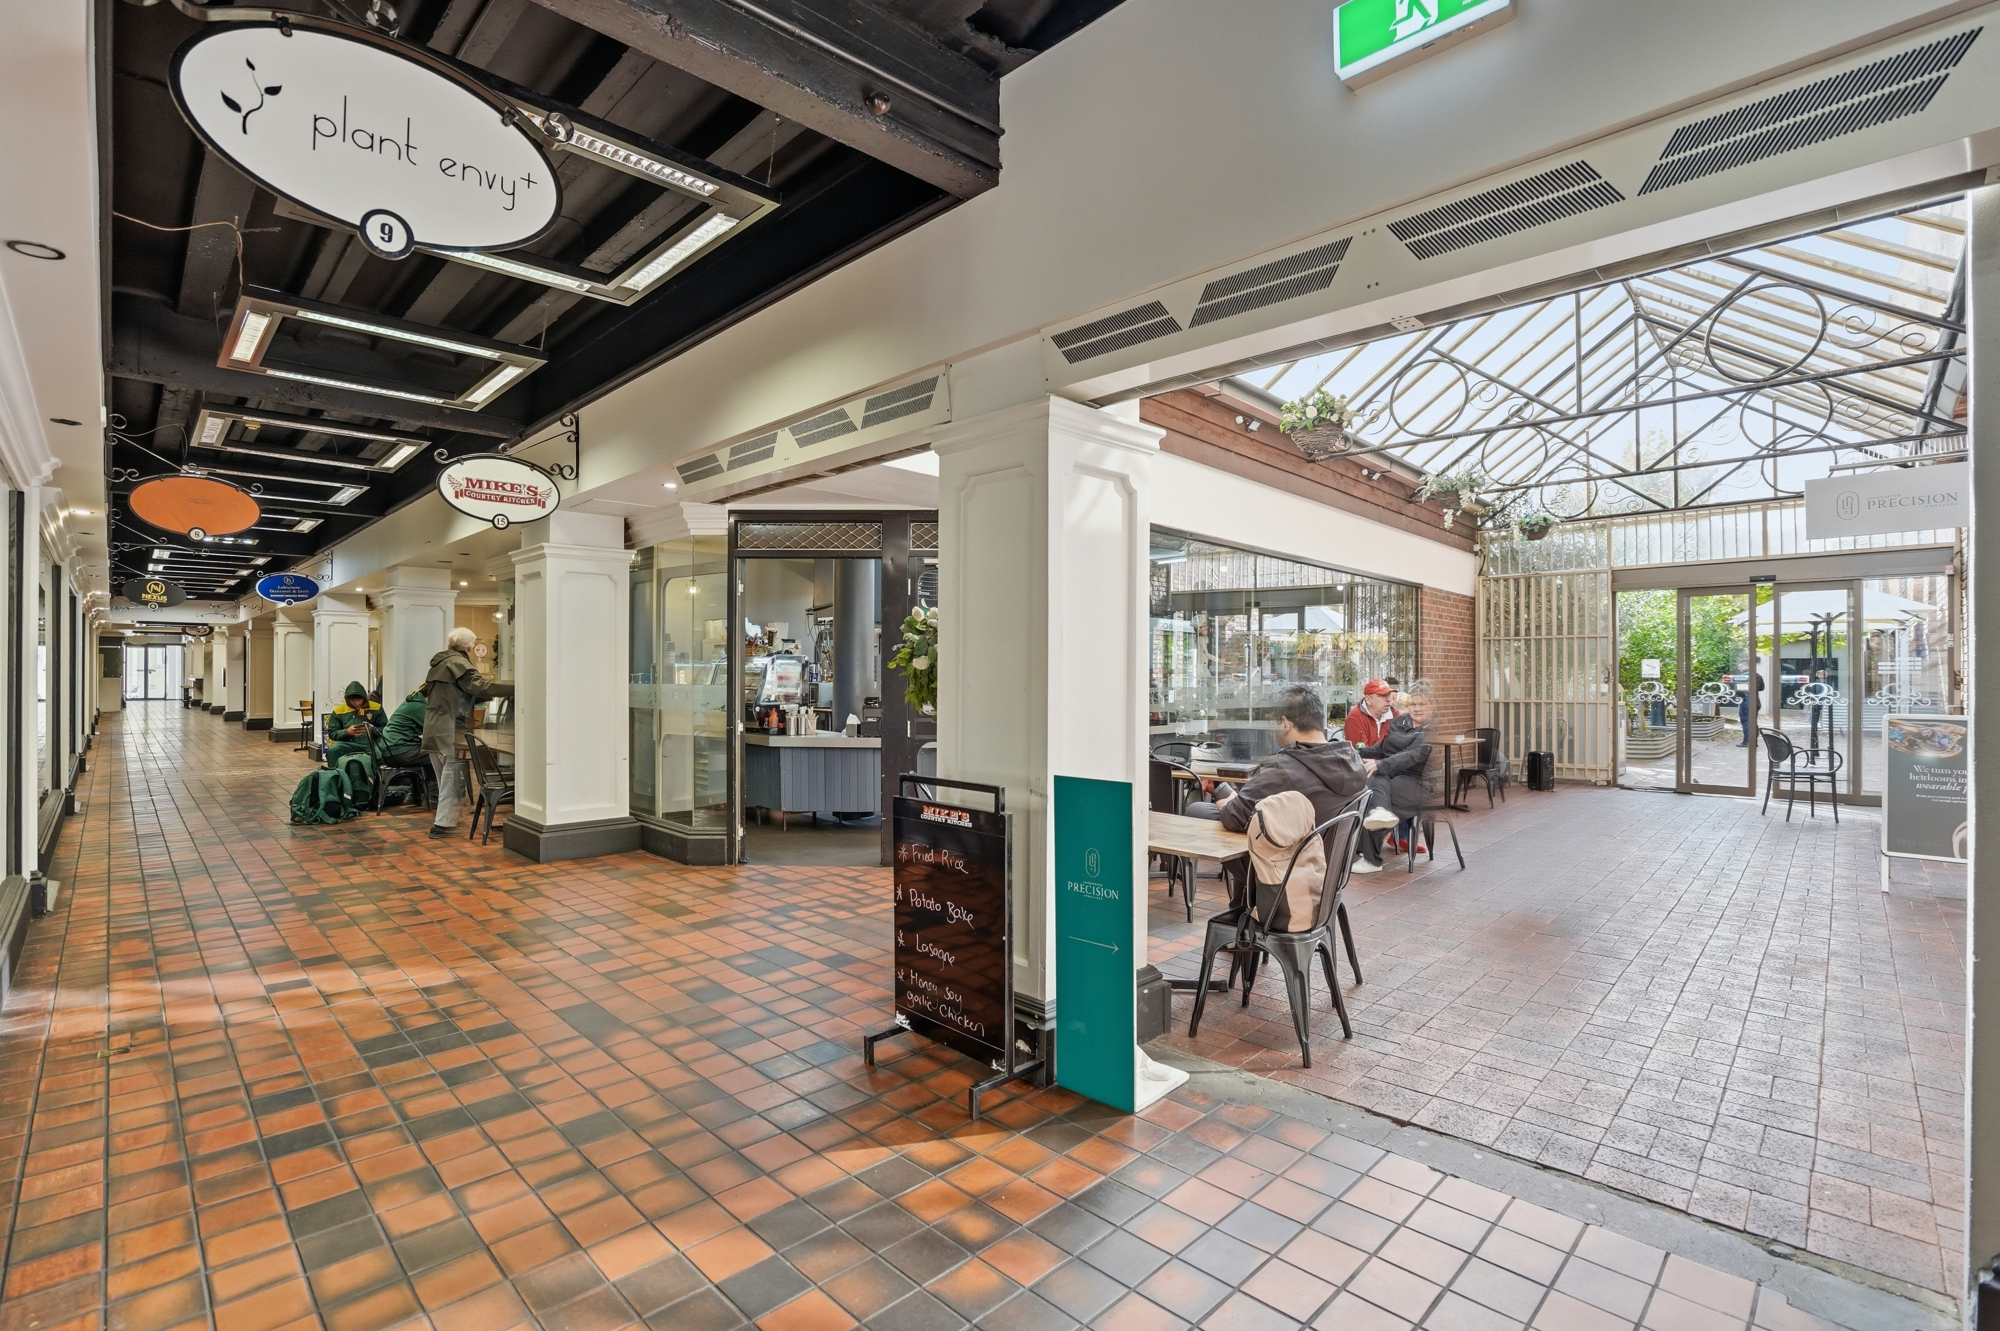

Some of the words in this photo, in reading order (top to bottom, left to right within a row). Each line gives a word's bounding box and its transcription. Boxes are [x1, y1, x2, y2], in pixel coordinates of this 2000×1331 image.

[312, 95, 418, 166] plant
[379, 222, 394, 243] 9
[464, 477, 538, 497] MIKE'S
[465, 490, 501, 501] COUNTRY
[503, 496, 536, 505] KITCHEN
[1867, 492, 1958, 510] PRECISION
[496, 517, 506, 526] 15
[194, 530, 201, 538] 8
[141, 592, 168, 601] NEXUS
[1909, 772, 1957, 783] heirlooms
[1913, 764, 1930, 773] We
[1915, 782, 1962, 791] wearable
[922, 805, 970, 822] MIKE'S
[912, 844, 935, 864] Fried
[941, 849, 969, 875] Rice
[1067, 881, 1119, 900] PRECISION
[909, 888, 942, 911] Potato
[946, 901, 975, 930] Bake
[916, 933, 955, 971] Lasagne
[910, 969, 938, 1010] Honey
[939, 1004, 985, 1037] Chicken
